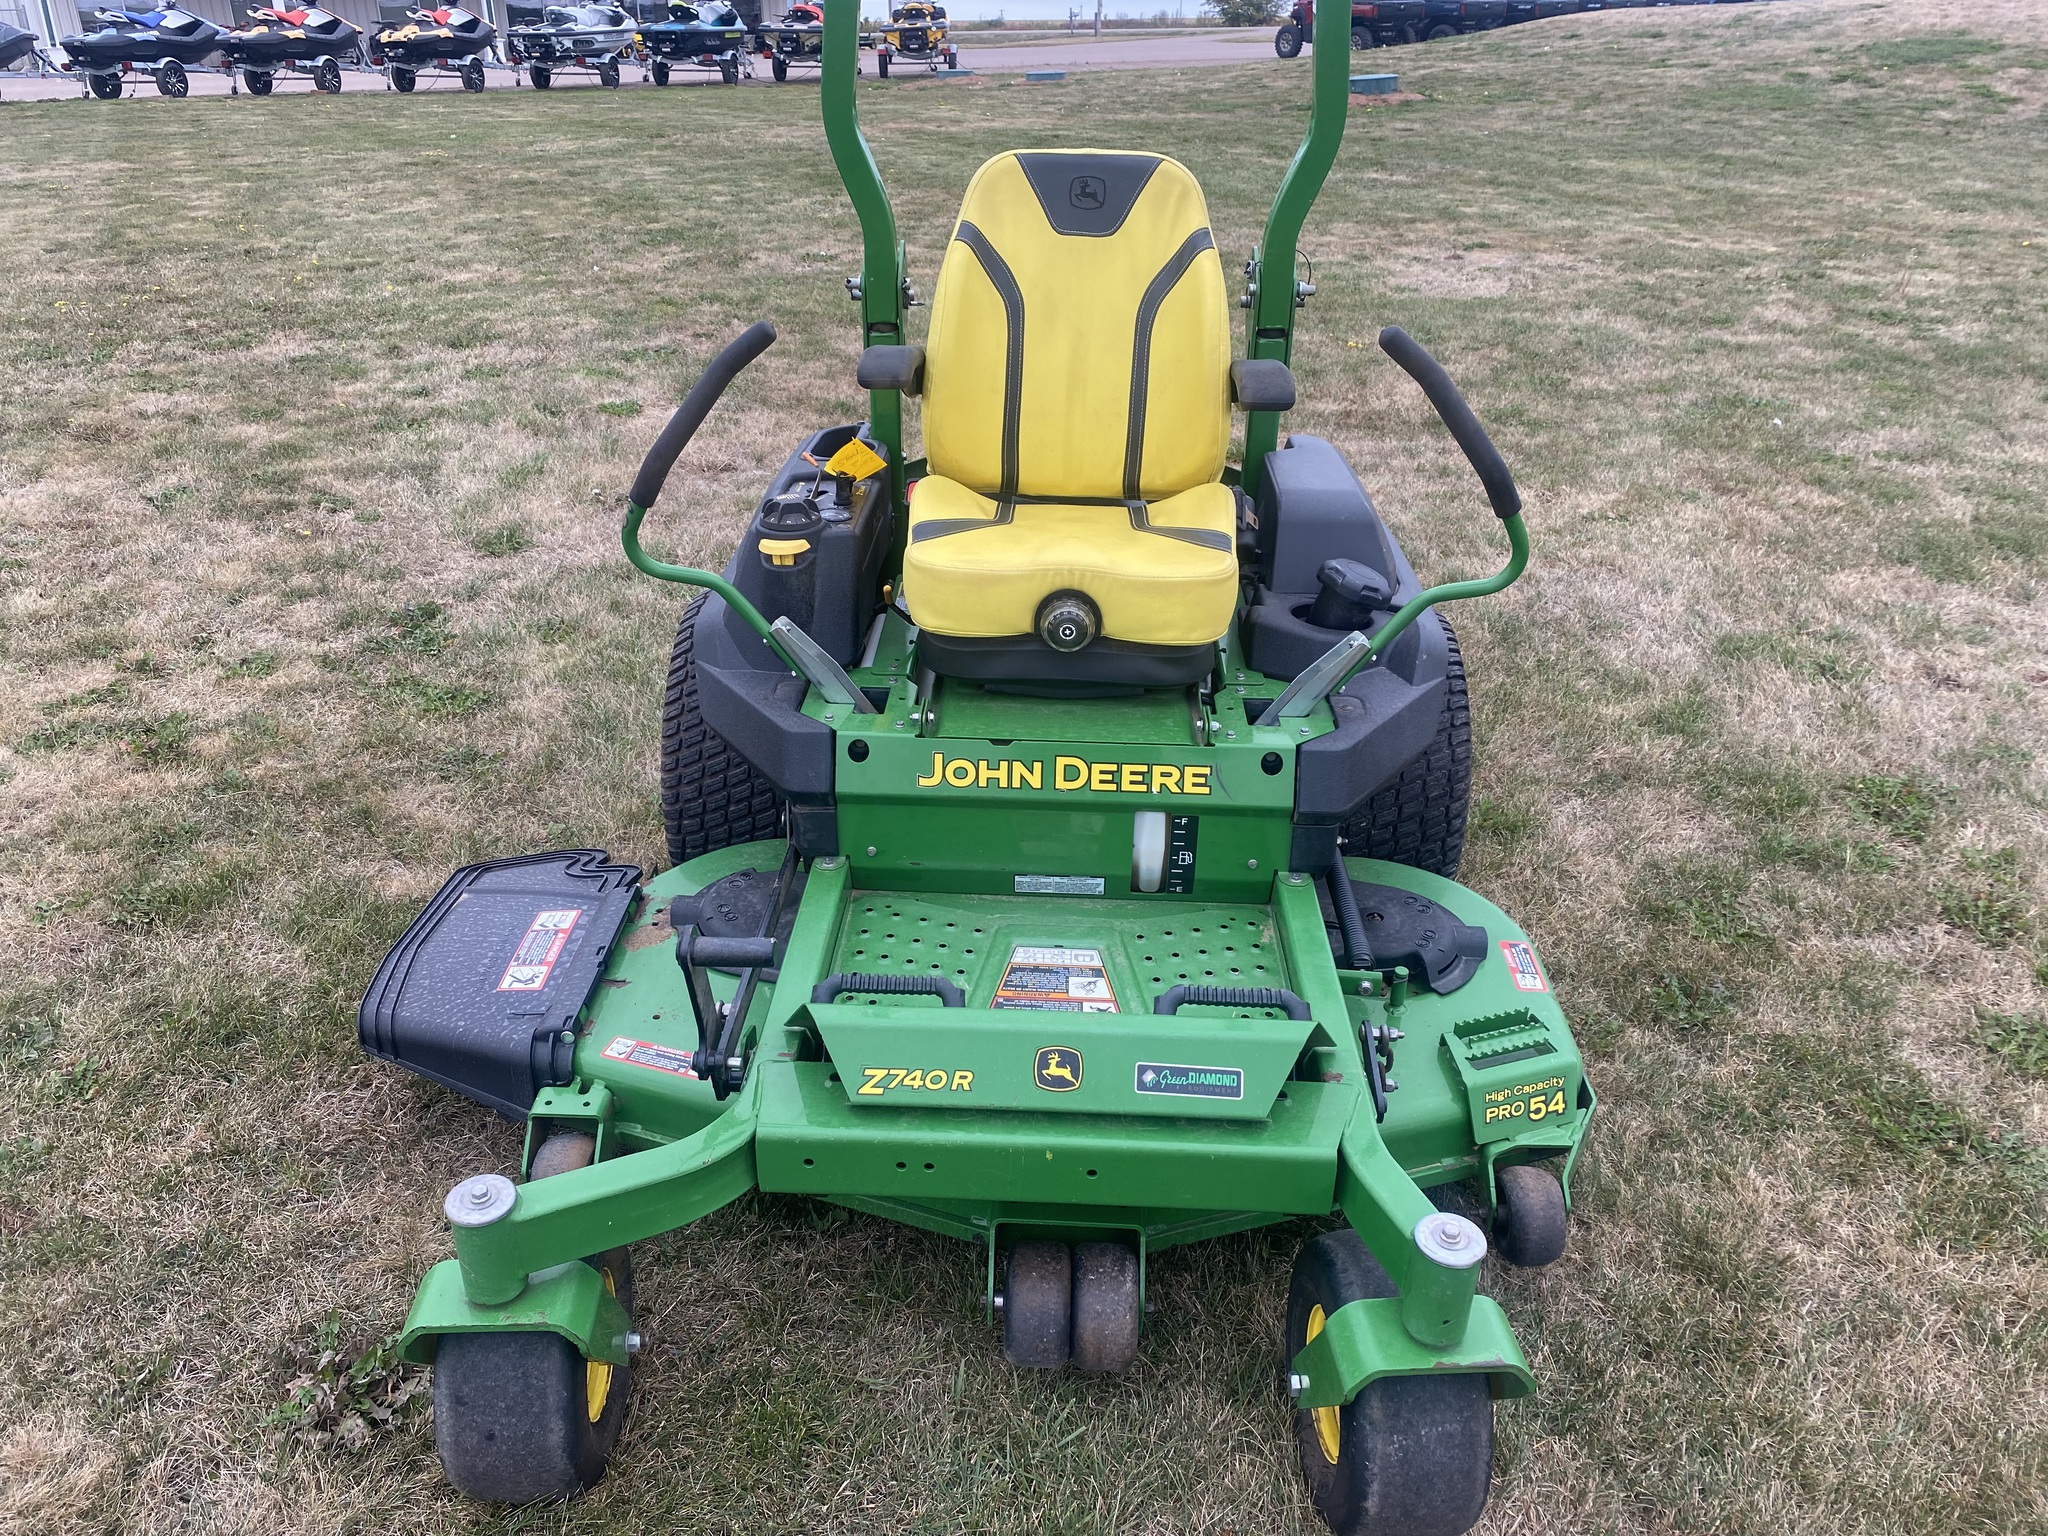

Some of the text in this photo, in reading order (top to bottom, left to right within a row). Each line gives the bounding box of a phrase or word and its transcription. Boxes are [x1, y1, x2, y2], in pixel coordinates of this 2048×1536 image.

[917, 751, 1213, 796] JOHN DEERE
[1181, 818, 1189, 826] F
[1485, 1075, 1566, 1104] High Capacity
[1484, 1089, 1567, 1124] PRO 54
